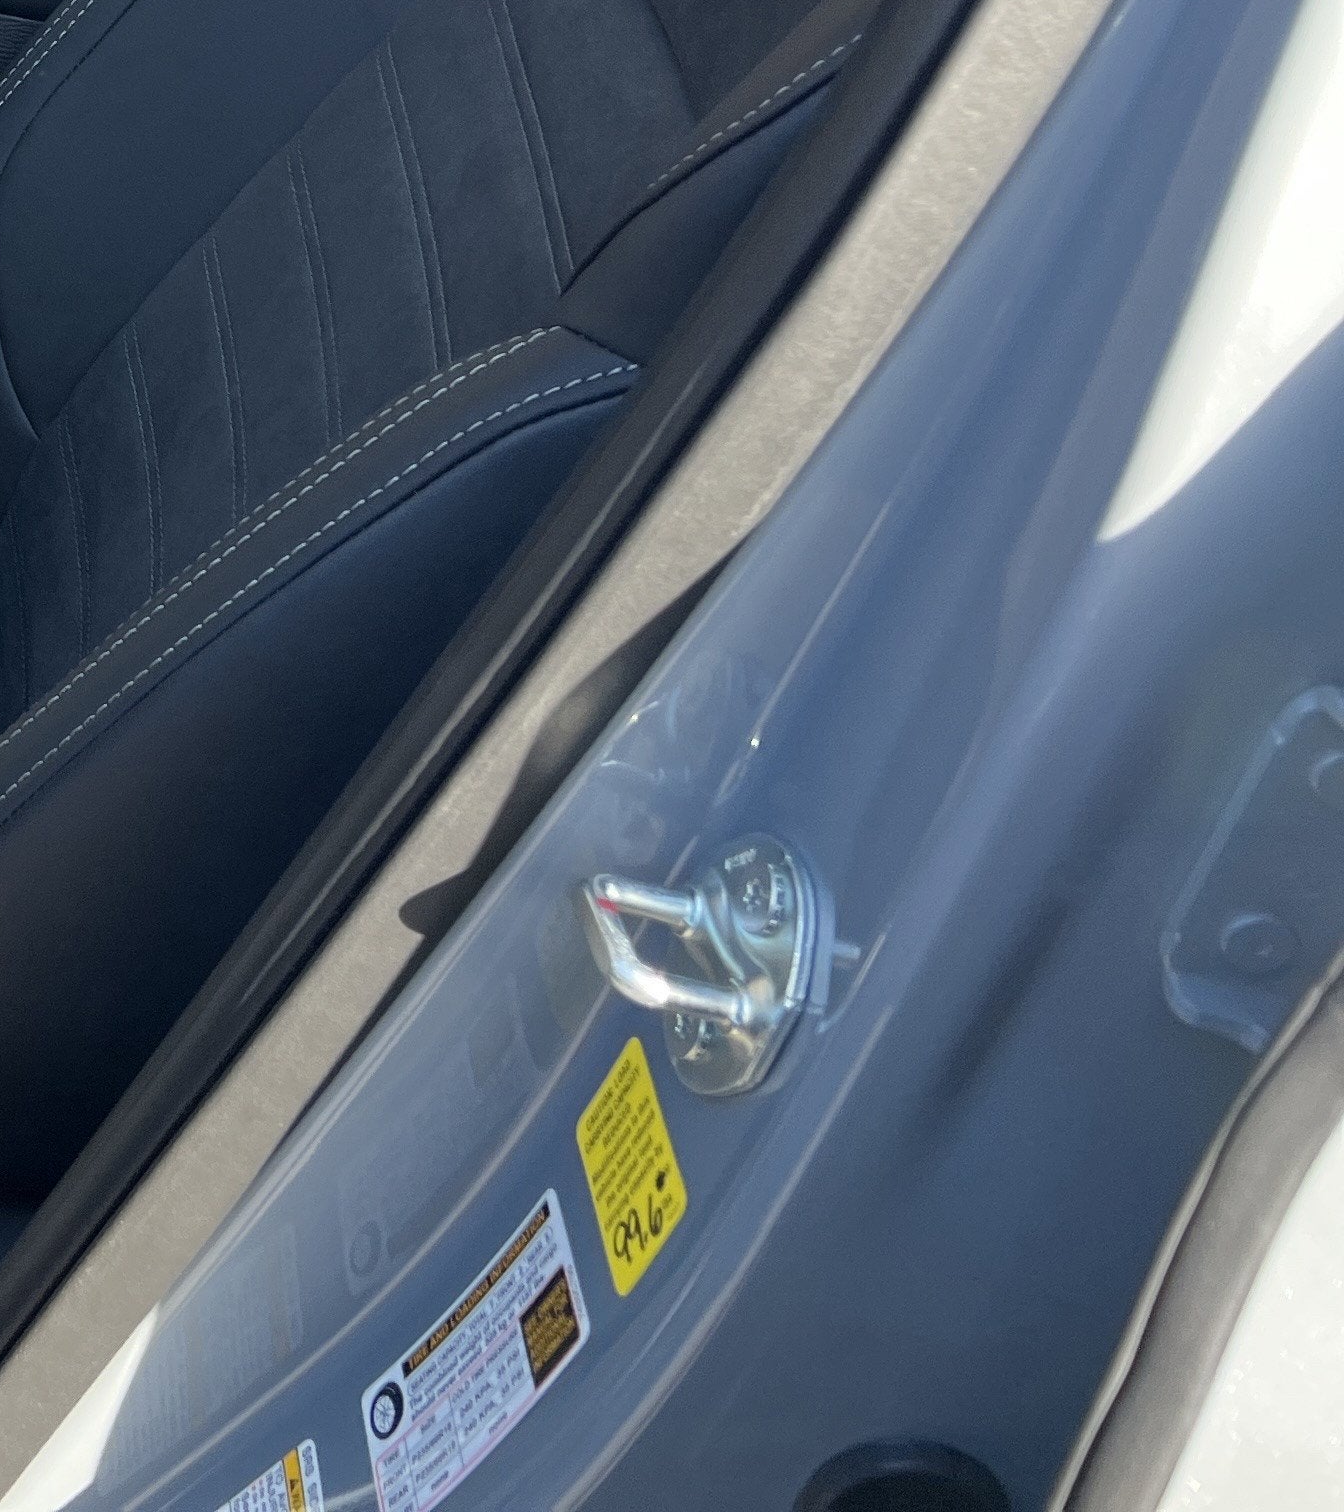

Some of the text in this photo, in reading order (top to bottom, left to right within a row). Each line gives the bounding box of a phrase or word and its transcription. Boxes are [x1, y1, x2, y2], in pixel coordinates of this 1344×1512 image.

[409, 1211, 545, 1369] TIRE AND LOADING INFORMATION
